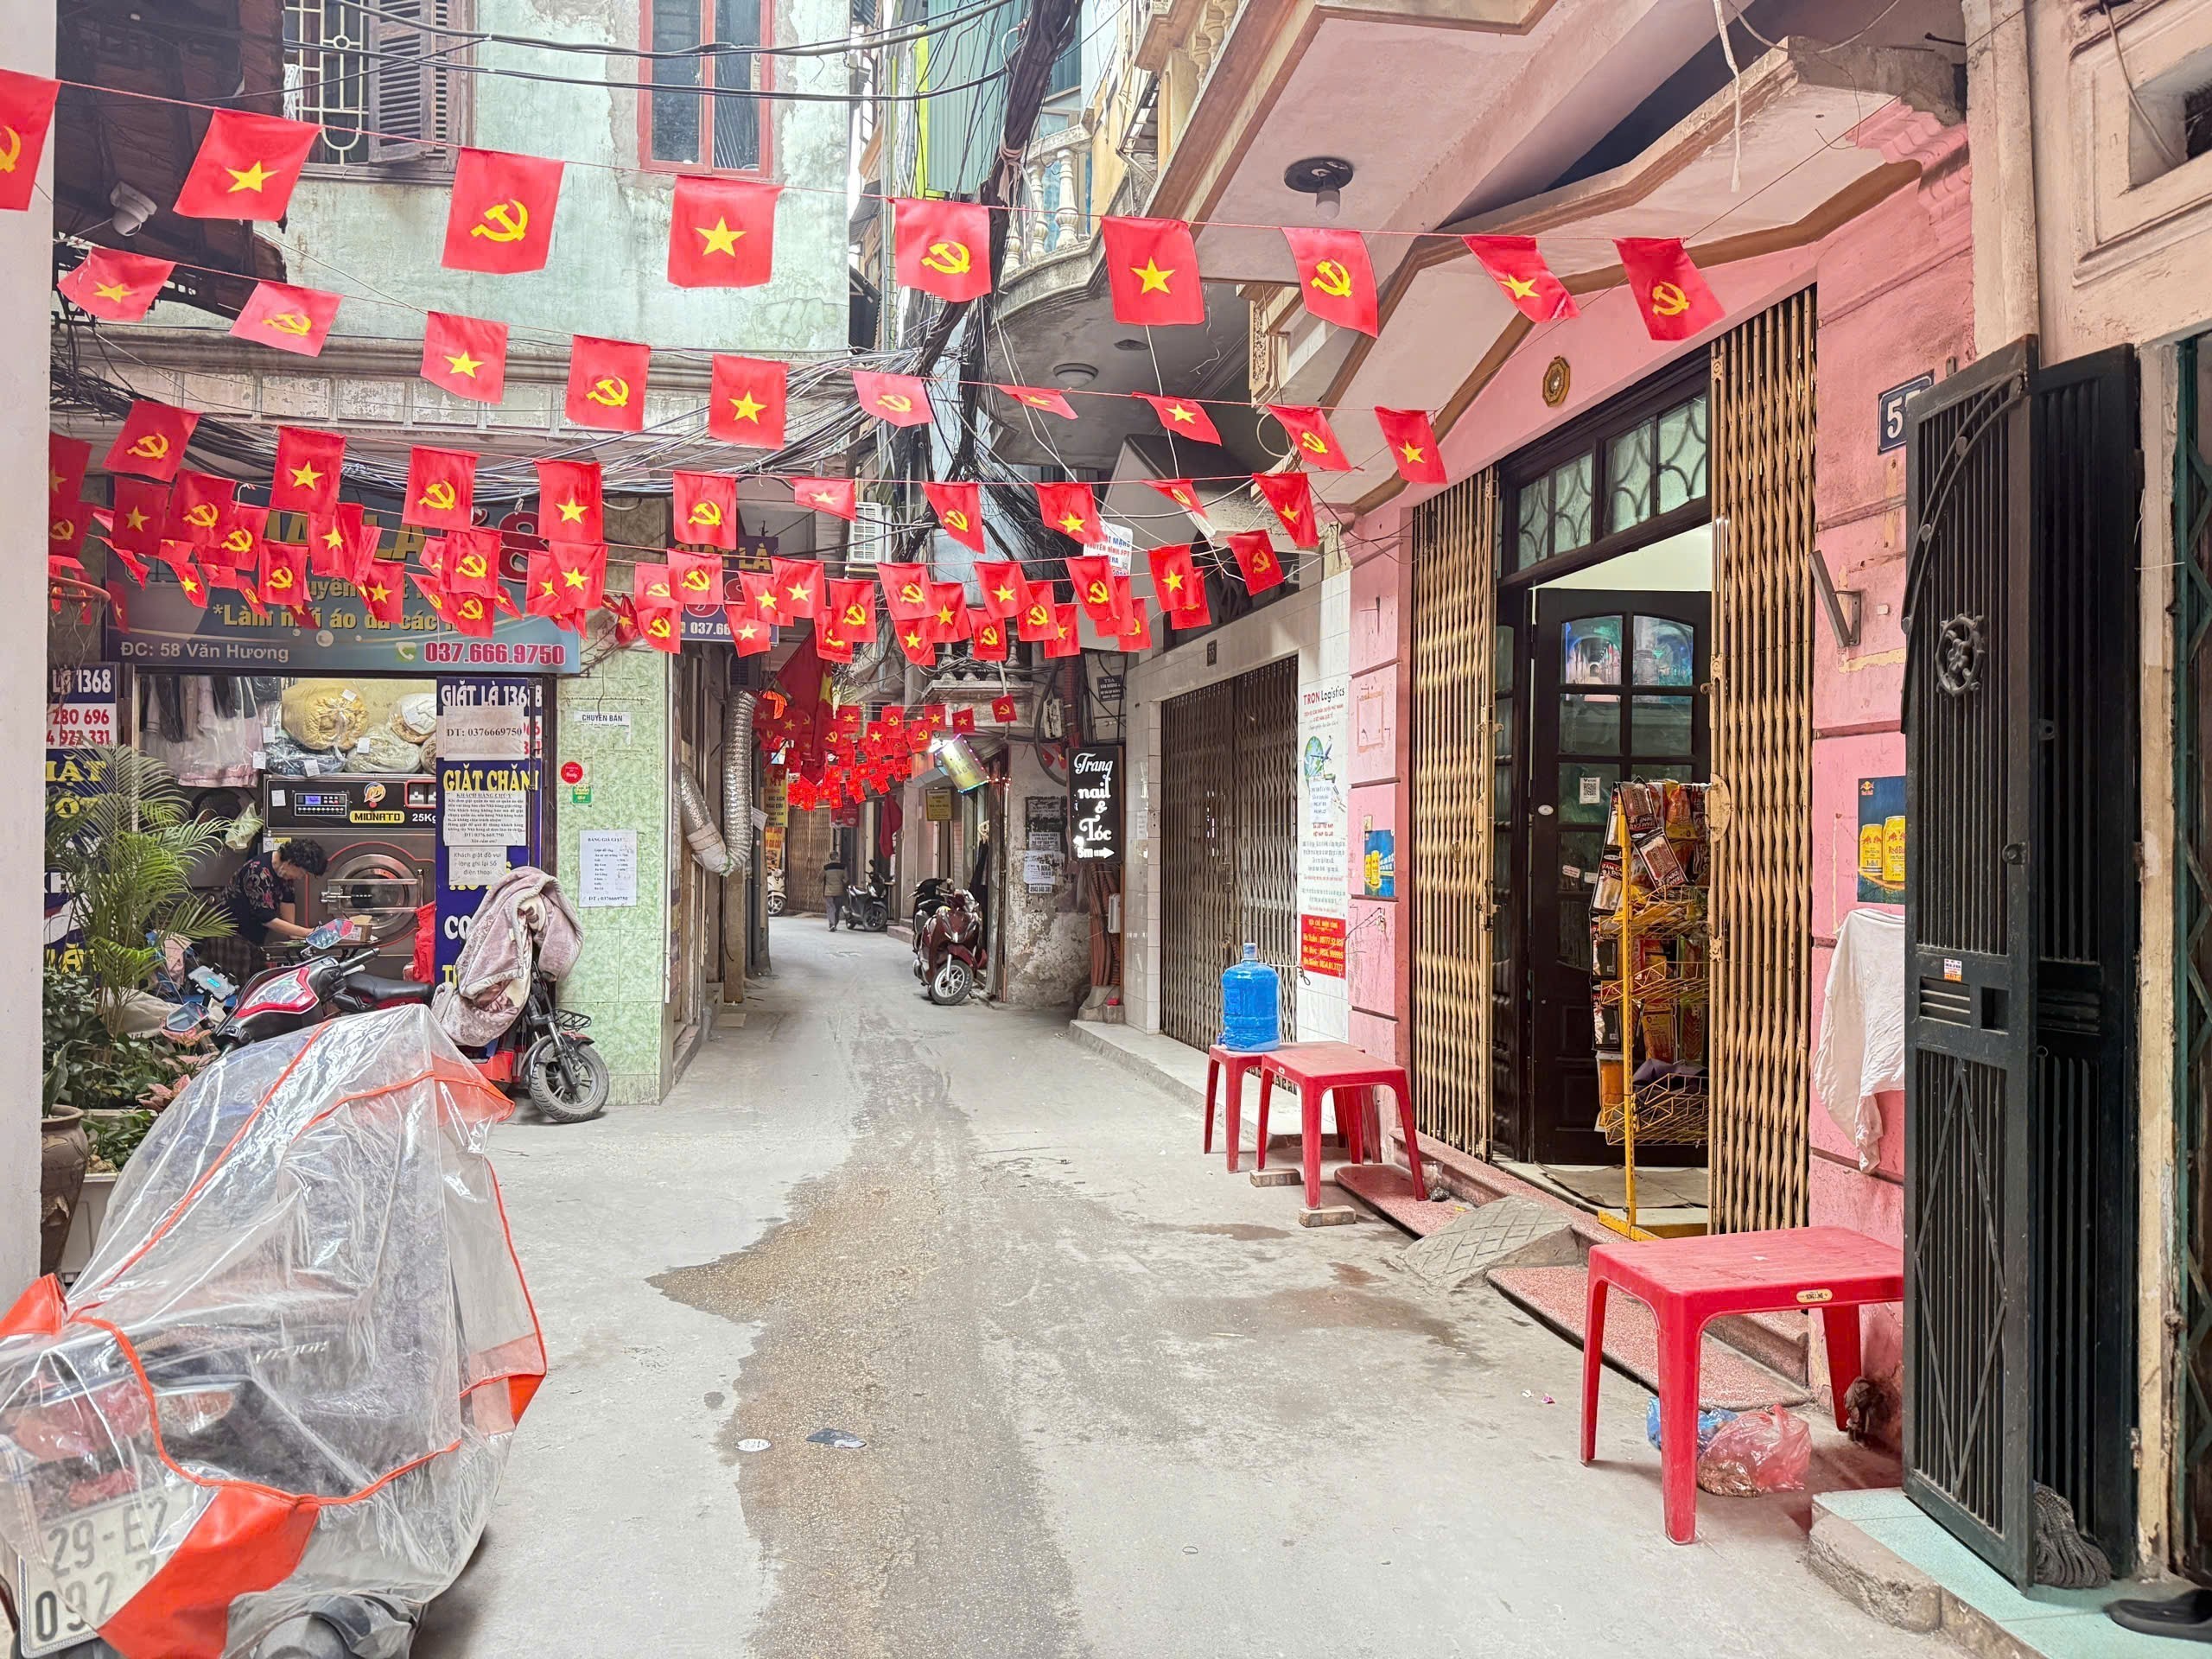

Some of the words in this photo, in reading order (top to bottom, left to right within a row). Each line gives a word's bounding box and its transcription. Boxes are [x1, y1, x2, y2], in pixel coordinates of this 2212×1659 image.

[739, 543, 771, 570] LÀ
[120, 642, 154, 658] ĐC:
[160, 642, 181, 658] 58
[187, 642, 220, 658] Văn
[226, 644, 289, 664] Hương
[424, 642, 565, 665] 037.666.9750
[77, 669, 111, 694] 1368
[481, 680, 499, 707] LÀ
[1303, 691, 1320, 705] TRON
[1321, 685, 1344, 702] Logistics
[53, 709, 79, 726] 280
[84, 709, 110, 725] 696
[467, 728, 523, 737] 0376669750
[1074, 753, 1113, 779] Trang
[1077, 777, 1111, 799] nail
[1095, 800, 1108, 814] &
[1079, 815, 1112, 842] Tóc
